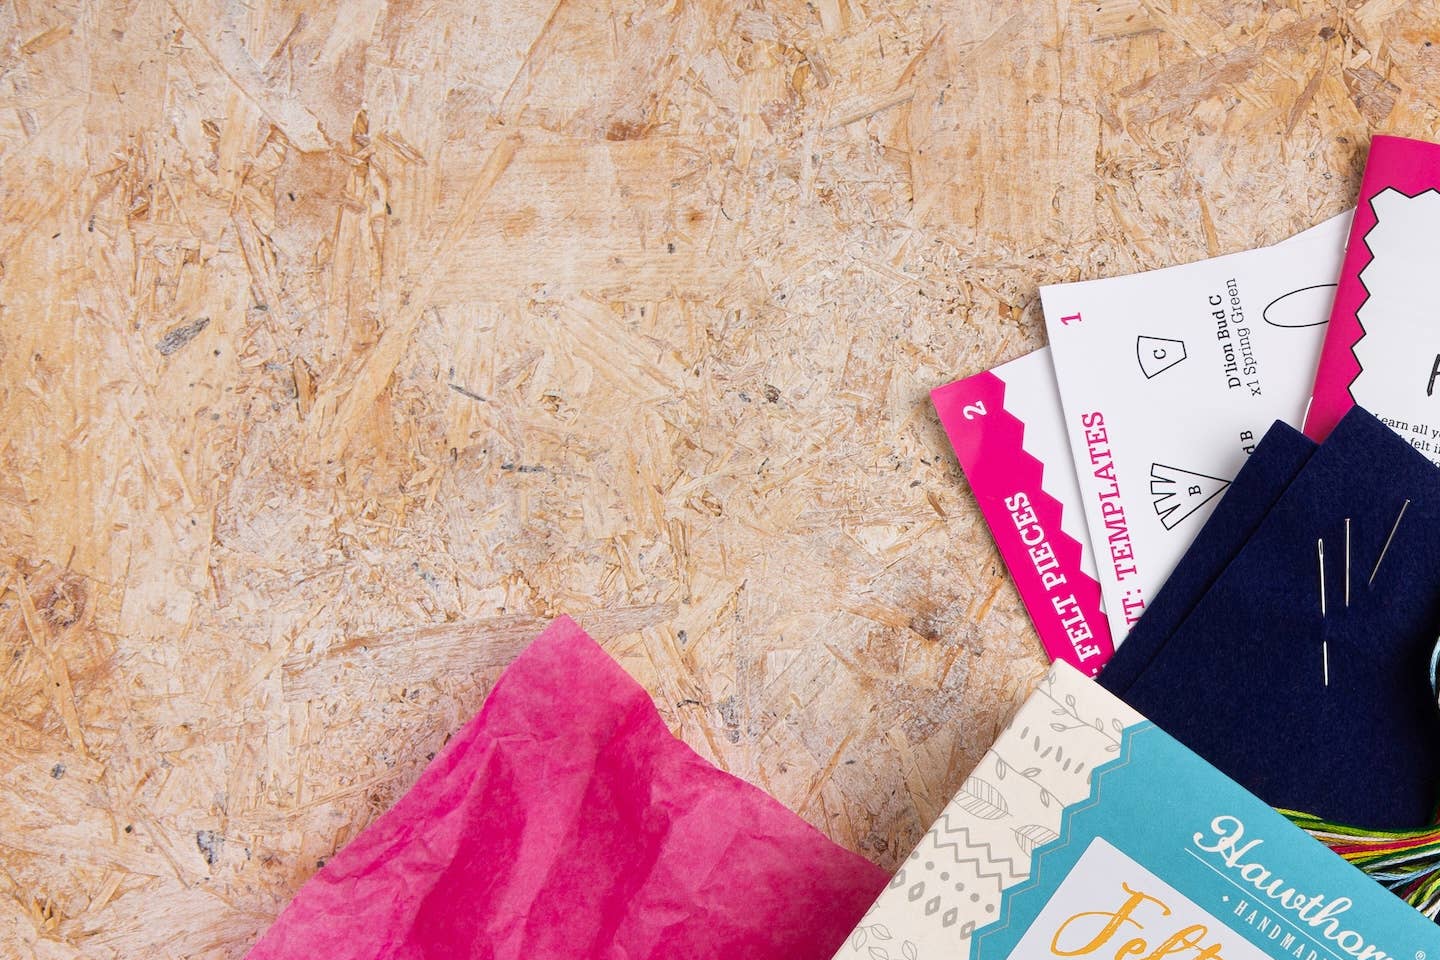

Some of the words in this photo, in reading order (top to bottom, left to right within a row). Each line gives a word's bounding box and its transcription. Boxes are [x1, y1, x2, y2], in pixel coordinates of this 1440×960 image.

[1209, 294, 1222, 306] C
[1226, 278, 1245, 324] Green
[1060, 312, 1082, 325] 1
[1212, 309, 1230, 341] Bud
[1153, 348, 1167, 360] C
[1237, 327, 1257, 376] Spring
[1222, 343, 1241, 389] D'lion
[1246, 379, 1262, 396] x1
[962, 400, 987, 420] 2
[1412, 421, 1428, 436] all
[1409, 437, 1430, 452] felt
[1081, 411, 1137, 581] TEMPLATES
[1188, 484, 1201, 496] B
[1004, 491, 1067, 591] PIECES
[1051, 594, 1101, 662] FELT
